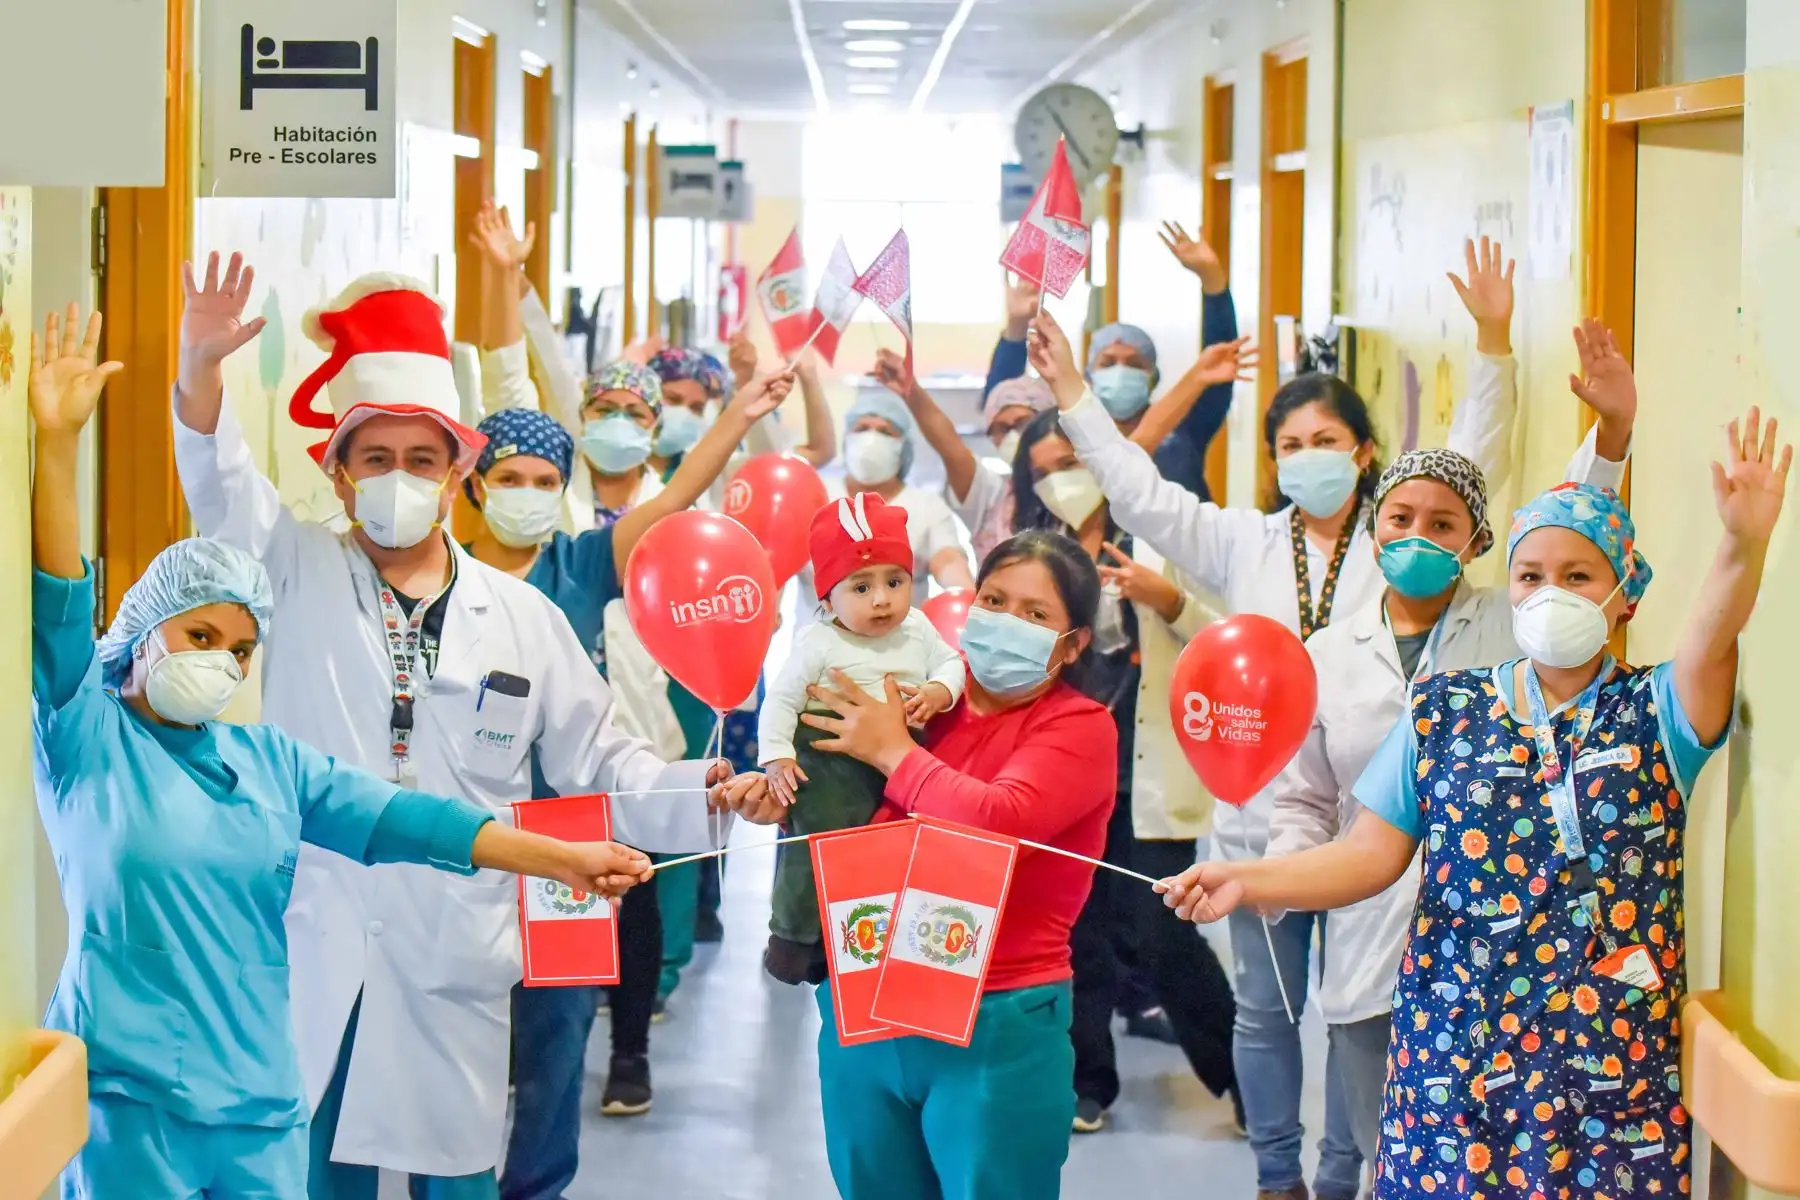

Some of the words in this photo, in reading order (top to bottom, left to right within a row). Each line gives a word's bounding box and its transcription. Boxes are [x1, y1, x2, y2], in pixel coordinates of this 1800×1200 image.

[273, 126, 377, 142] Habitación
[230, 148, 262, 164] Pre
[281, 148, 377, 164] Escolares
[1213, 701, 1261, 719] Unidos
[1231, 718, 1268, 730] salvar
[487, 730, 516, 743] BMT
[1218, 725, 1261, 742] Vidas
